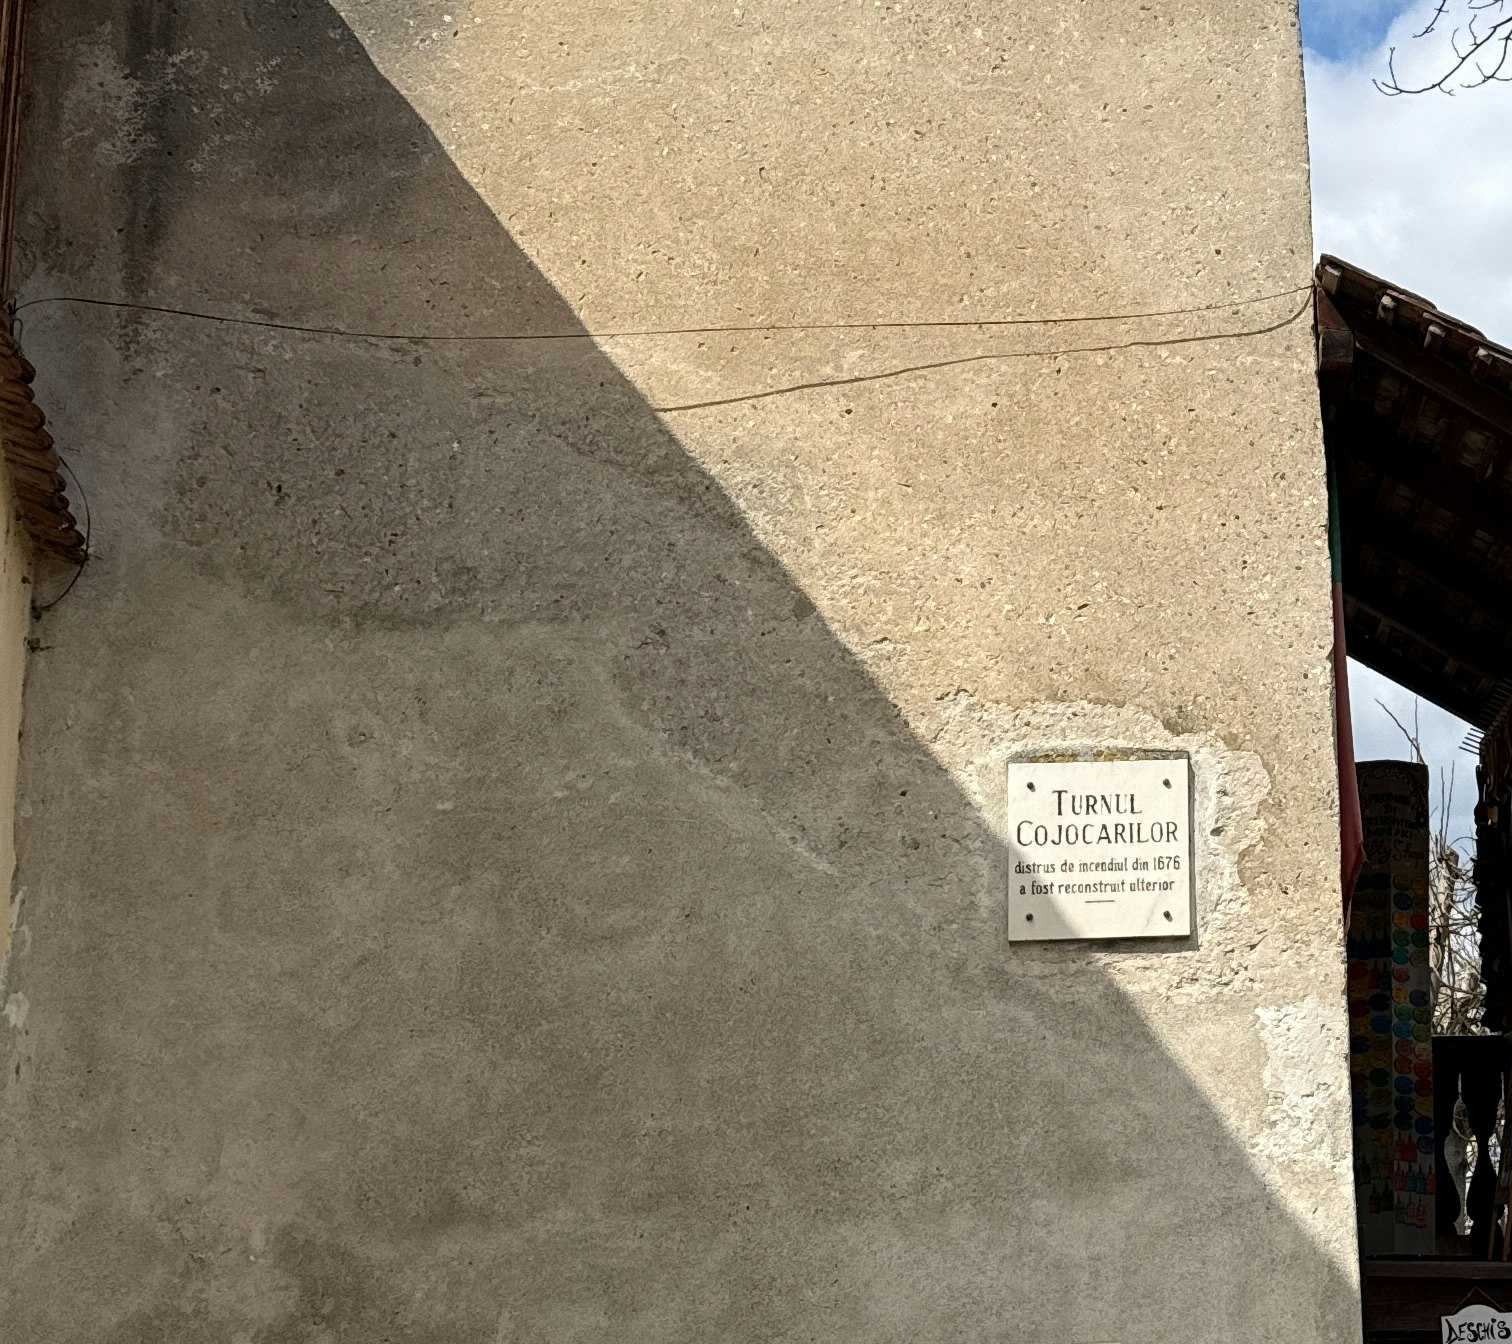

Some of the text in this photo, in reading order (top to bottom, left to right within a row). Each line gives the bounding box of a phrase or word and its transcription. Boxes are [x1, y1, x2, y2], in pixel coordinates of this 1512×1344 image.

[1052, 790, 1142, 816] TURNUL
[1016, 820, 1179, 847] COJOCARILOR
[1014, 855, 1181, 874] distrus de incendiul din 1676
[1019, 878, 1176, 895] a fost reconstruit ulterior
